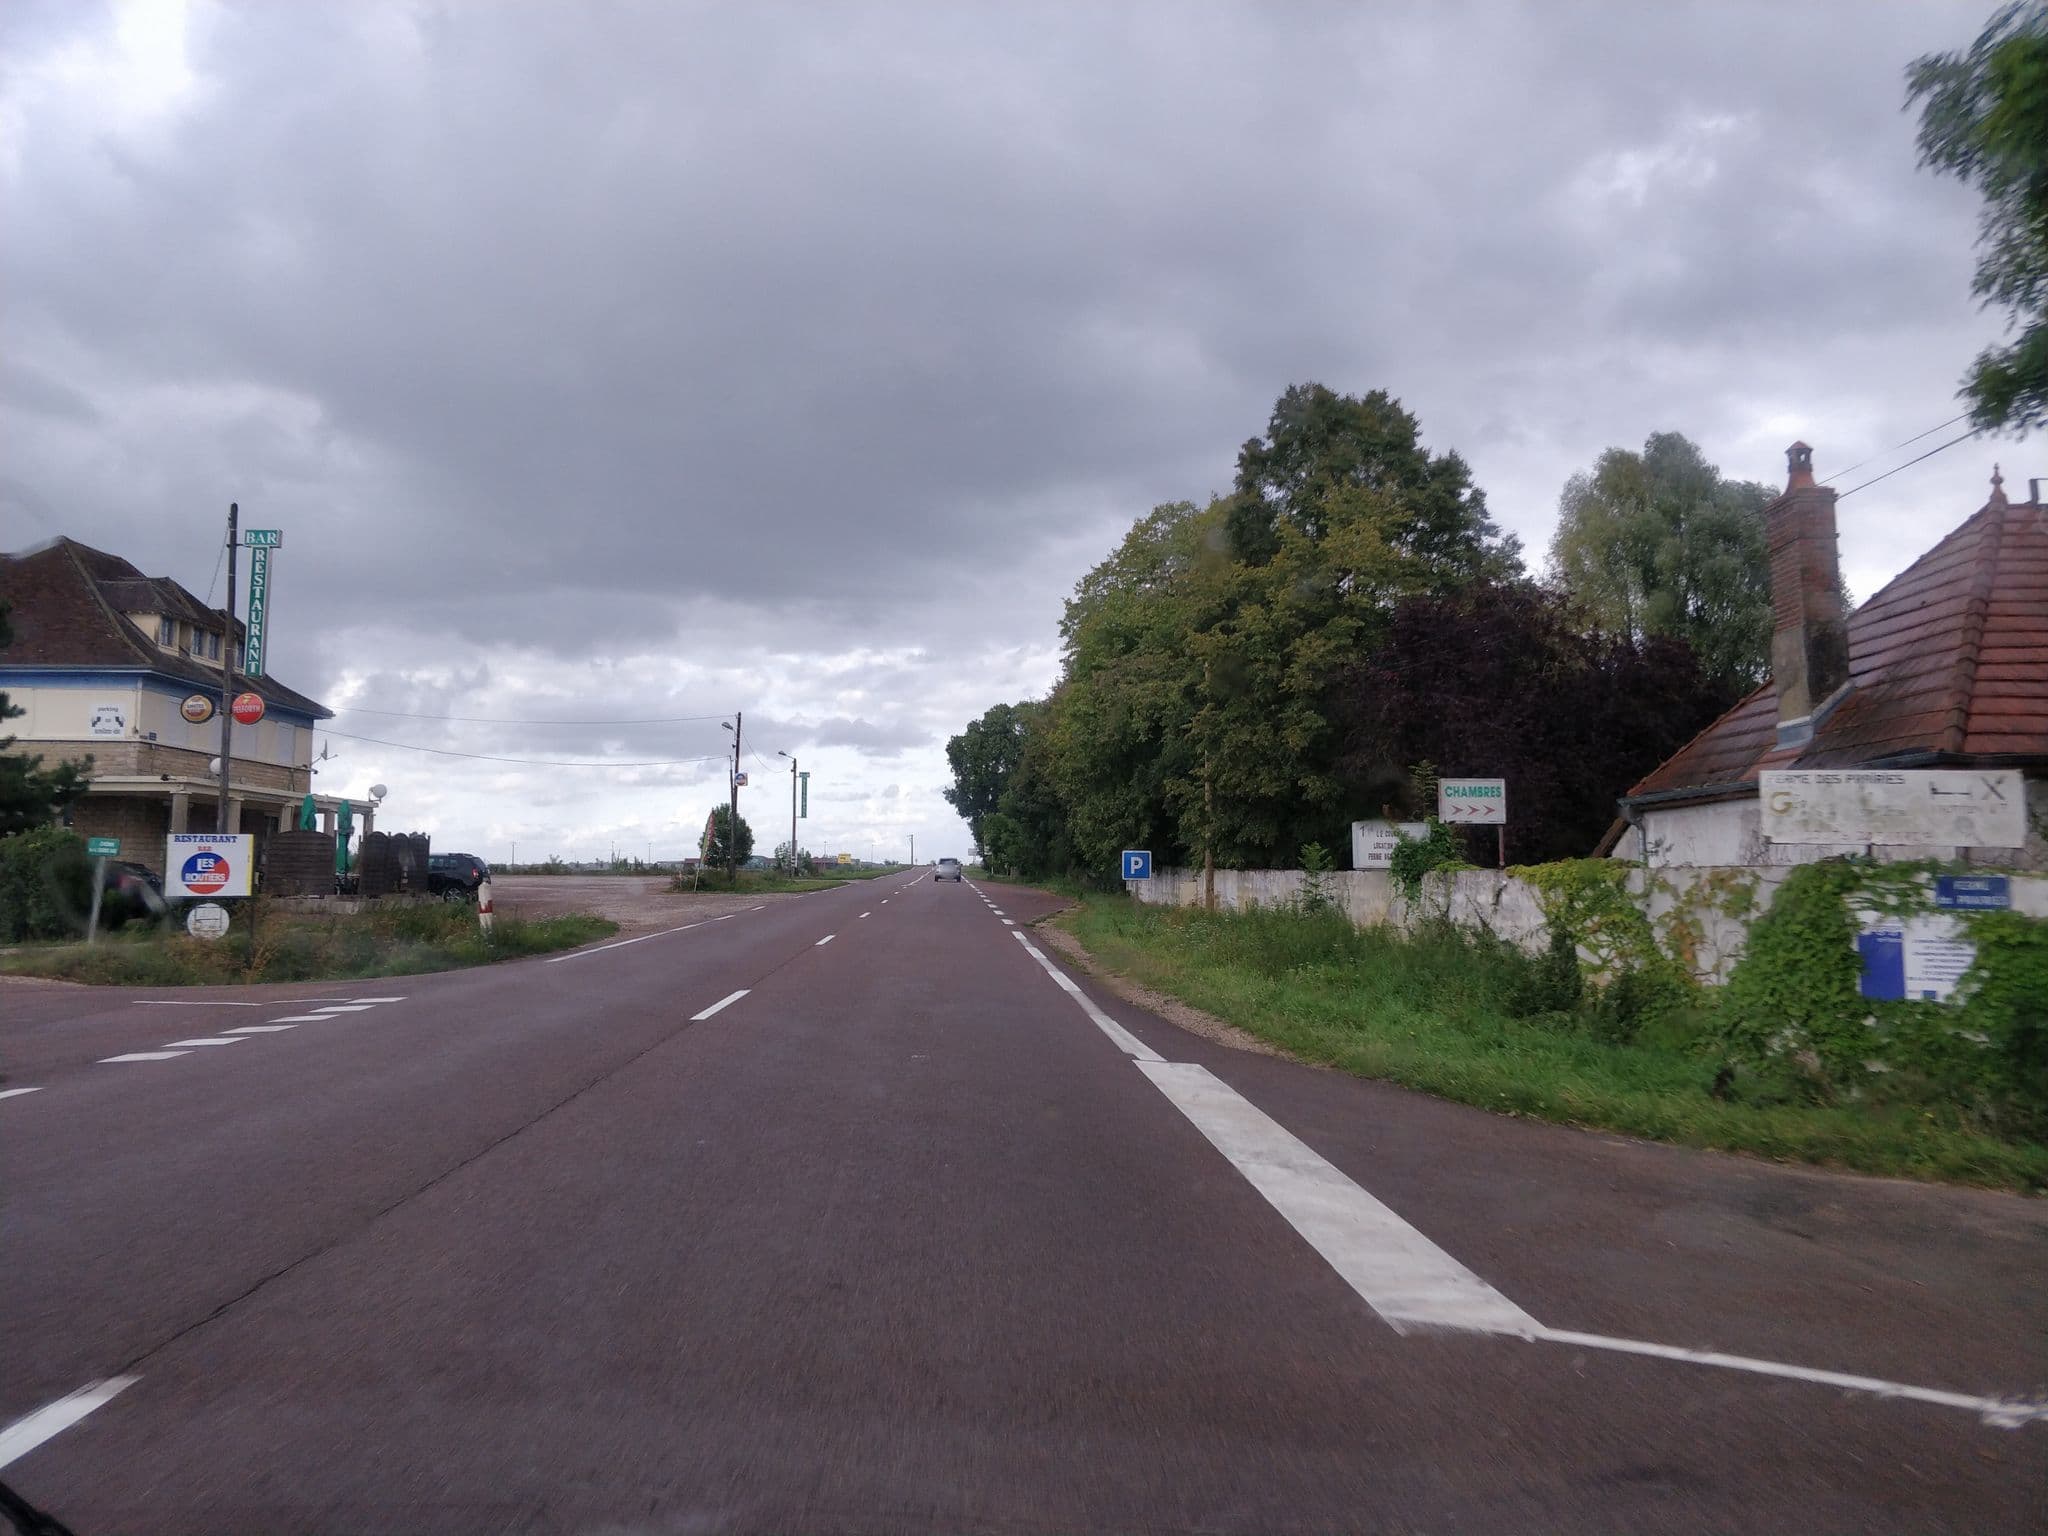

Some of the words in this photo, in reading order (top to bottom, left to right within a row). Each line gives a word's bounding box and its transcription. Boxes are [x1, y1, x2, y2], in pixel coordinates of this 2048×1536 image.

[246, 531, 278, 544] BAR
[247, 548, 268, 674] RESTAURANT
[1815, 774, 1842, 785] DES
[1444, 785, 1502, 798] CHAMBRES
[174, 835, 238, 843] RESTAURANT
[196, 858, 215, 871] LES
[1130, 856, 1144, 875] P
[185, 873, 226, 882] ROUTIERS
